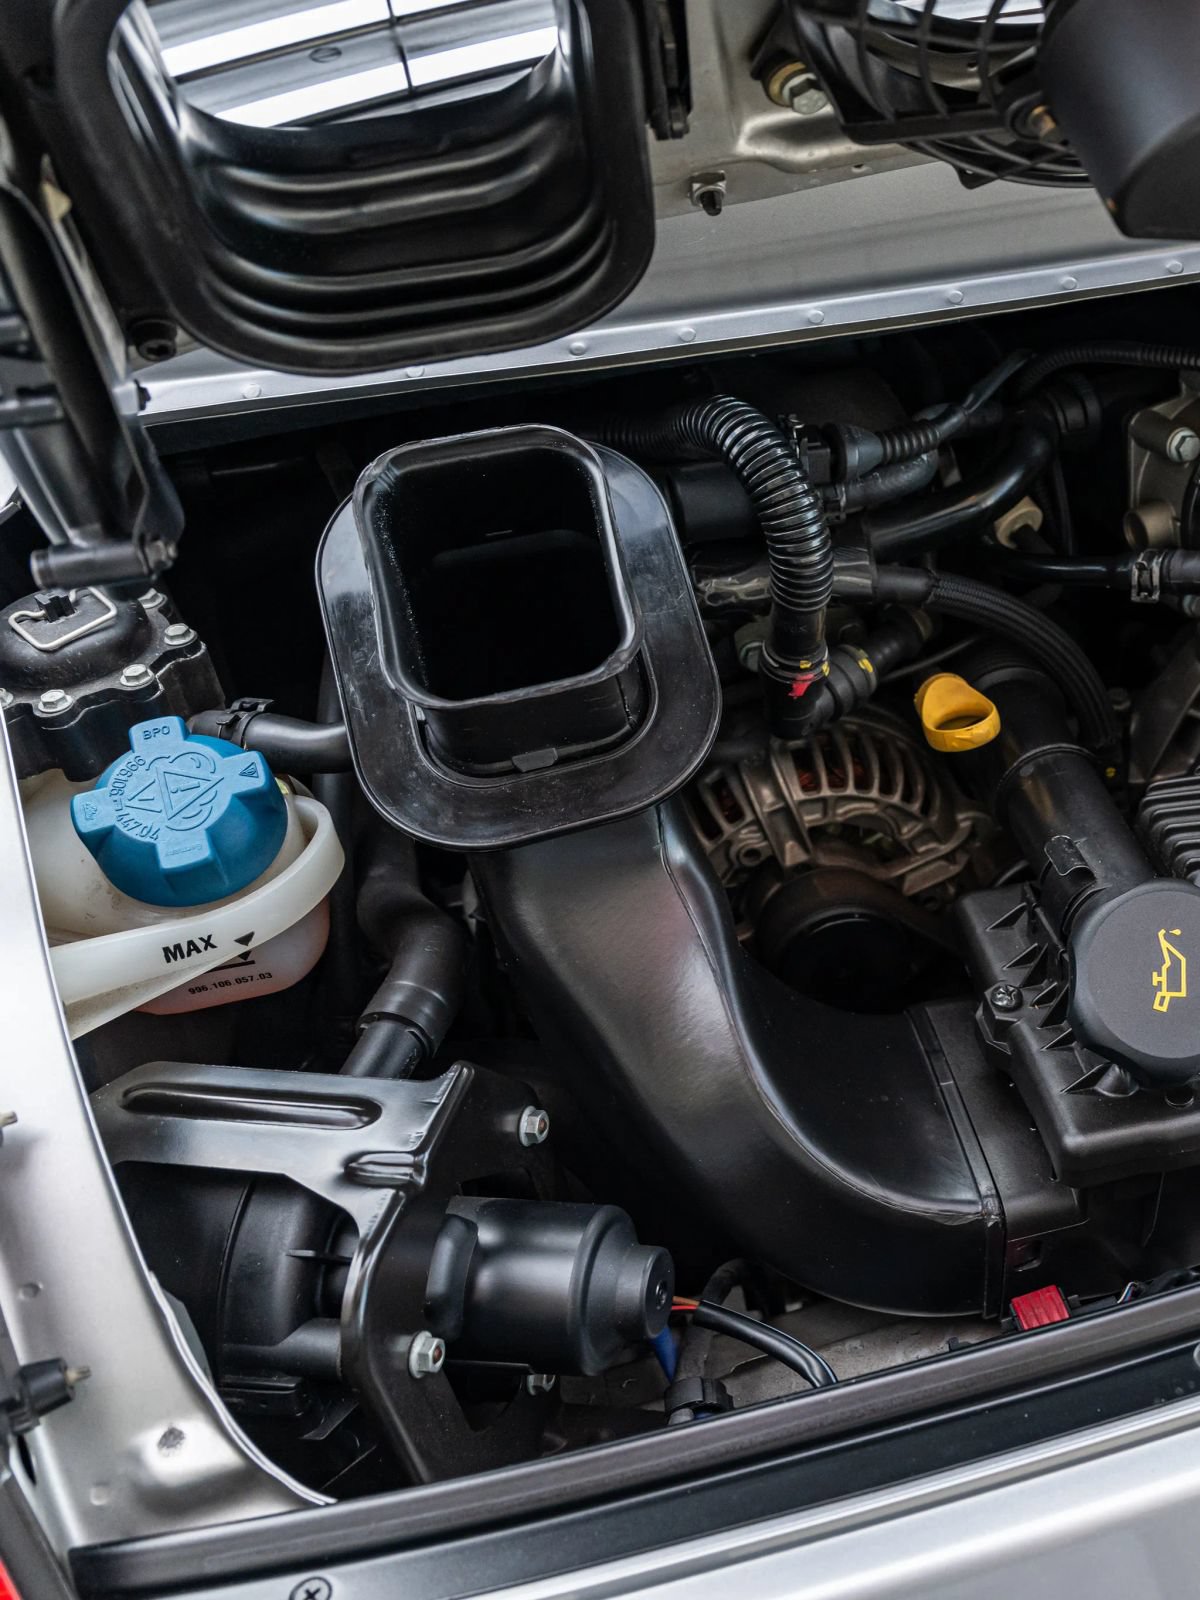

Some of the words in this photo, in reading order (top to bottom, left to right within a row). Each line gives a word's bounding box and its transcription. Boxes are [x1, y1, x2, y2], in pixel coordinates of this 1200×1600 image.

[142, 725, 171, 741] BPO
[162, 934, 218, 964] MAX
[187, 972, 273, 995] 996.106.057.03
